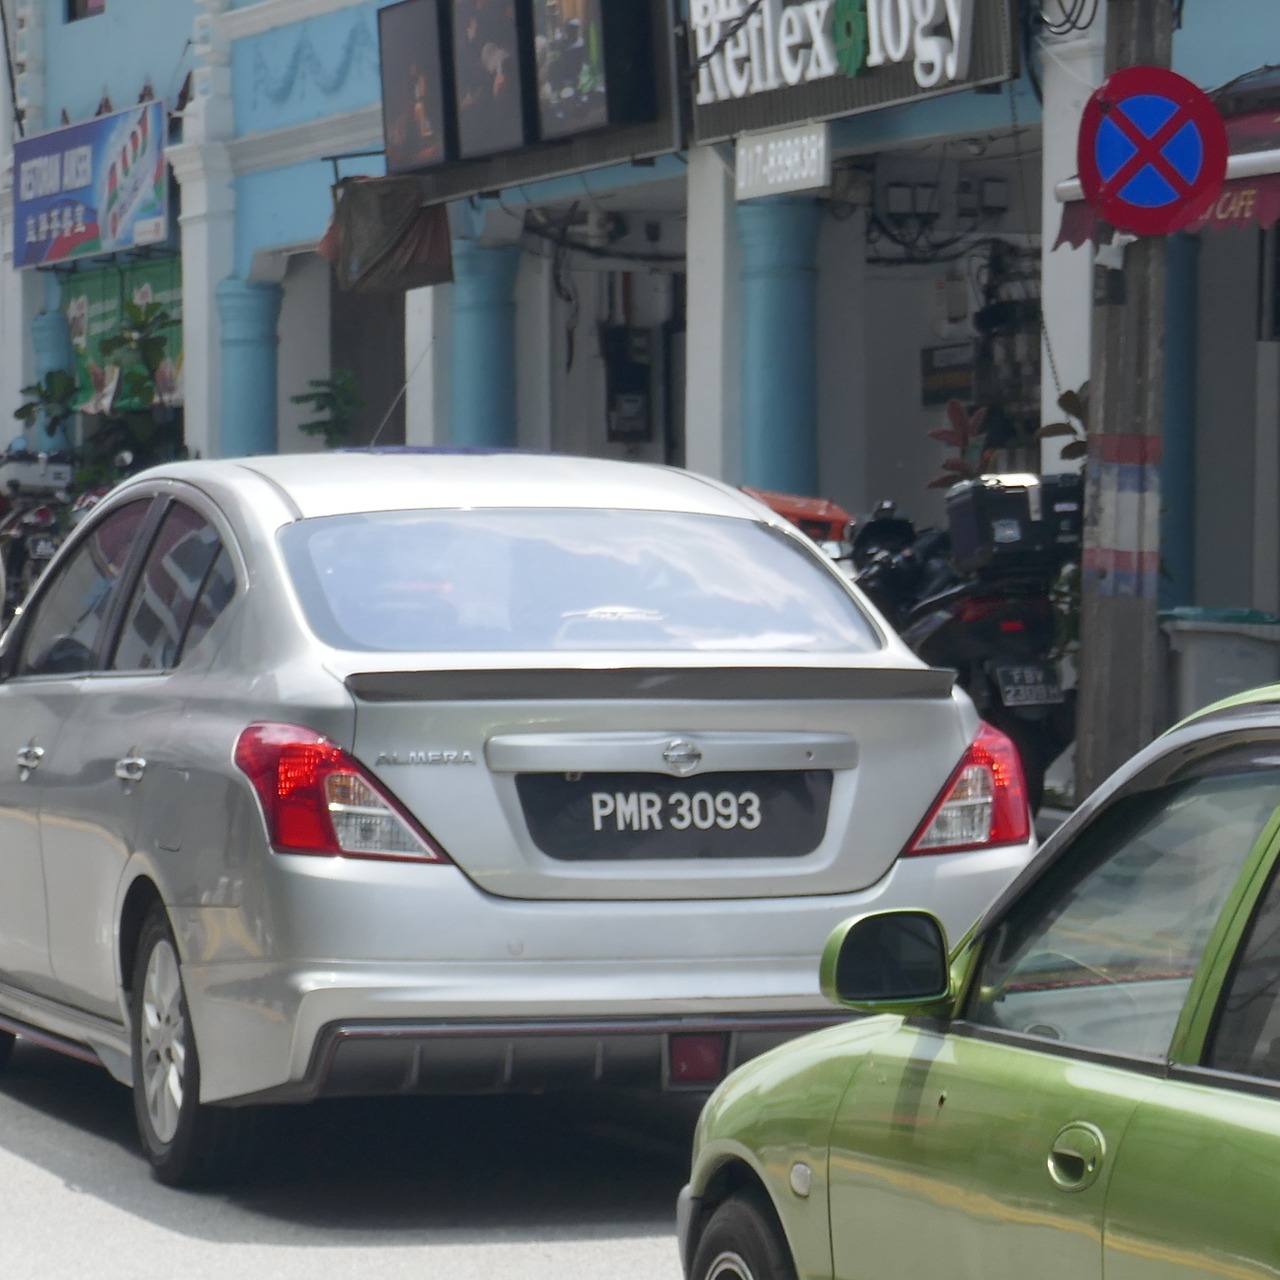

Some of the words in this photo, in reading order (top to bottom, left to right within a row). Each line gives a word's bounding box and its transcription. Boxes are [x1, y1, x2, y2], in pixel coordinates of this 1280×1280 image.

[375, 750, 476, 767] ALMERA
[591, 792, 664, 832] PMR
[668, 791, 763, 831] 3093
